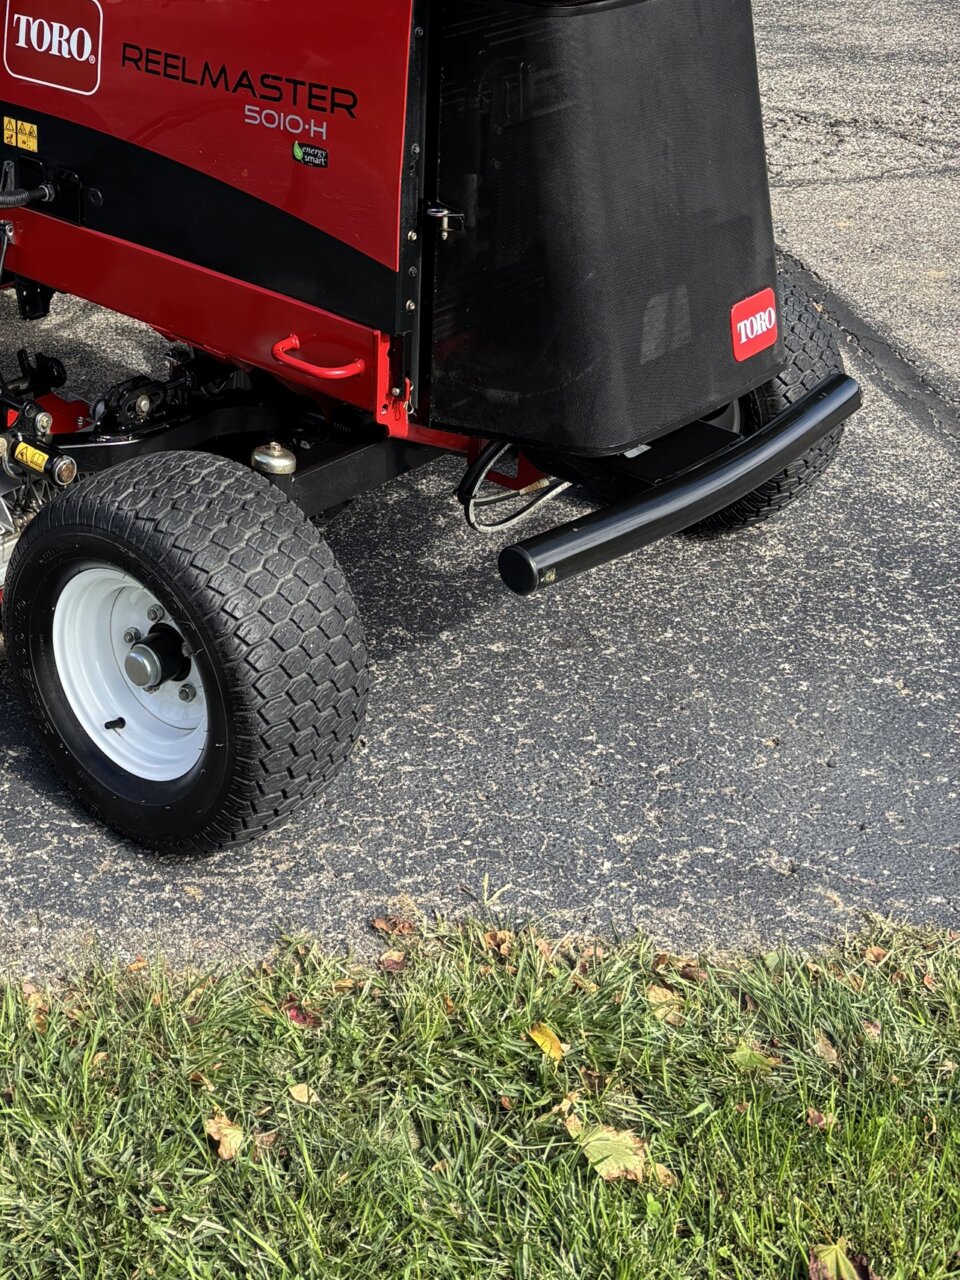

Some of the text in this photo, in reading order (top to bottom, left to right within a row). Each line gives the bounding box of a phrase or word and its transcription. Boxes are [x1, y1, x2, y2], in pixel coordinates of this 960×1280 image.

[13, 13, 92, 61] TORO
[121, 42, 358, 119] REELMASTER
[302, 146, 326, 158] energy
[304, 155, 326, 166] smart
[737, 306, 776, 344] TORO
